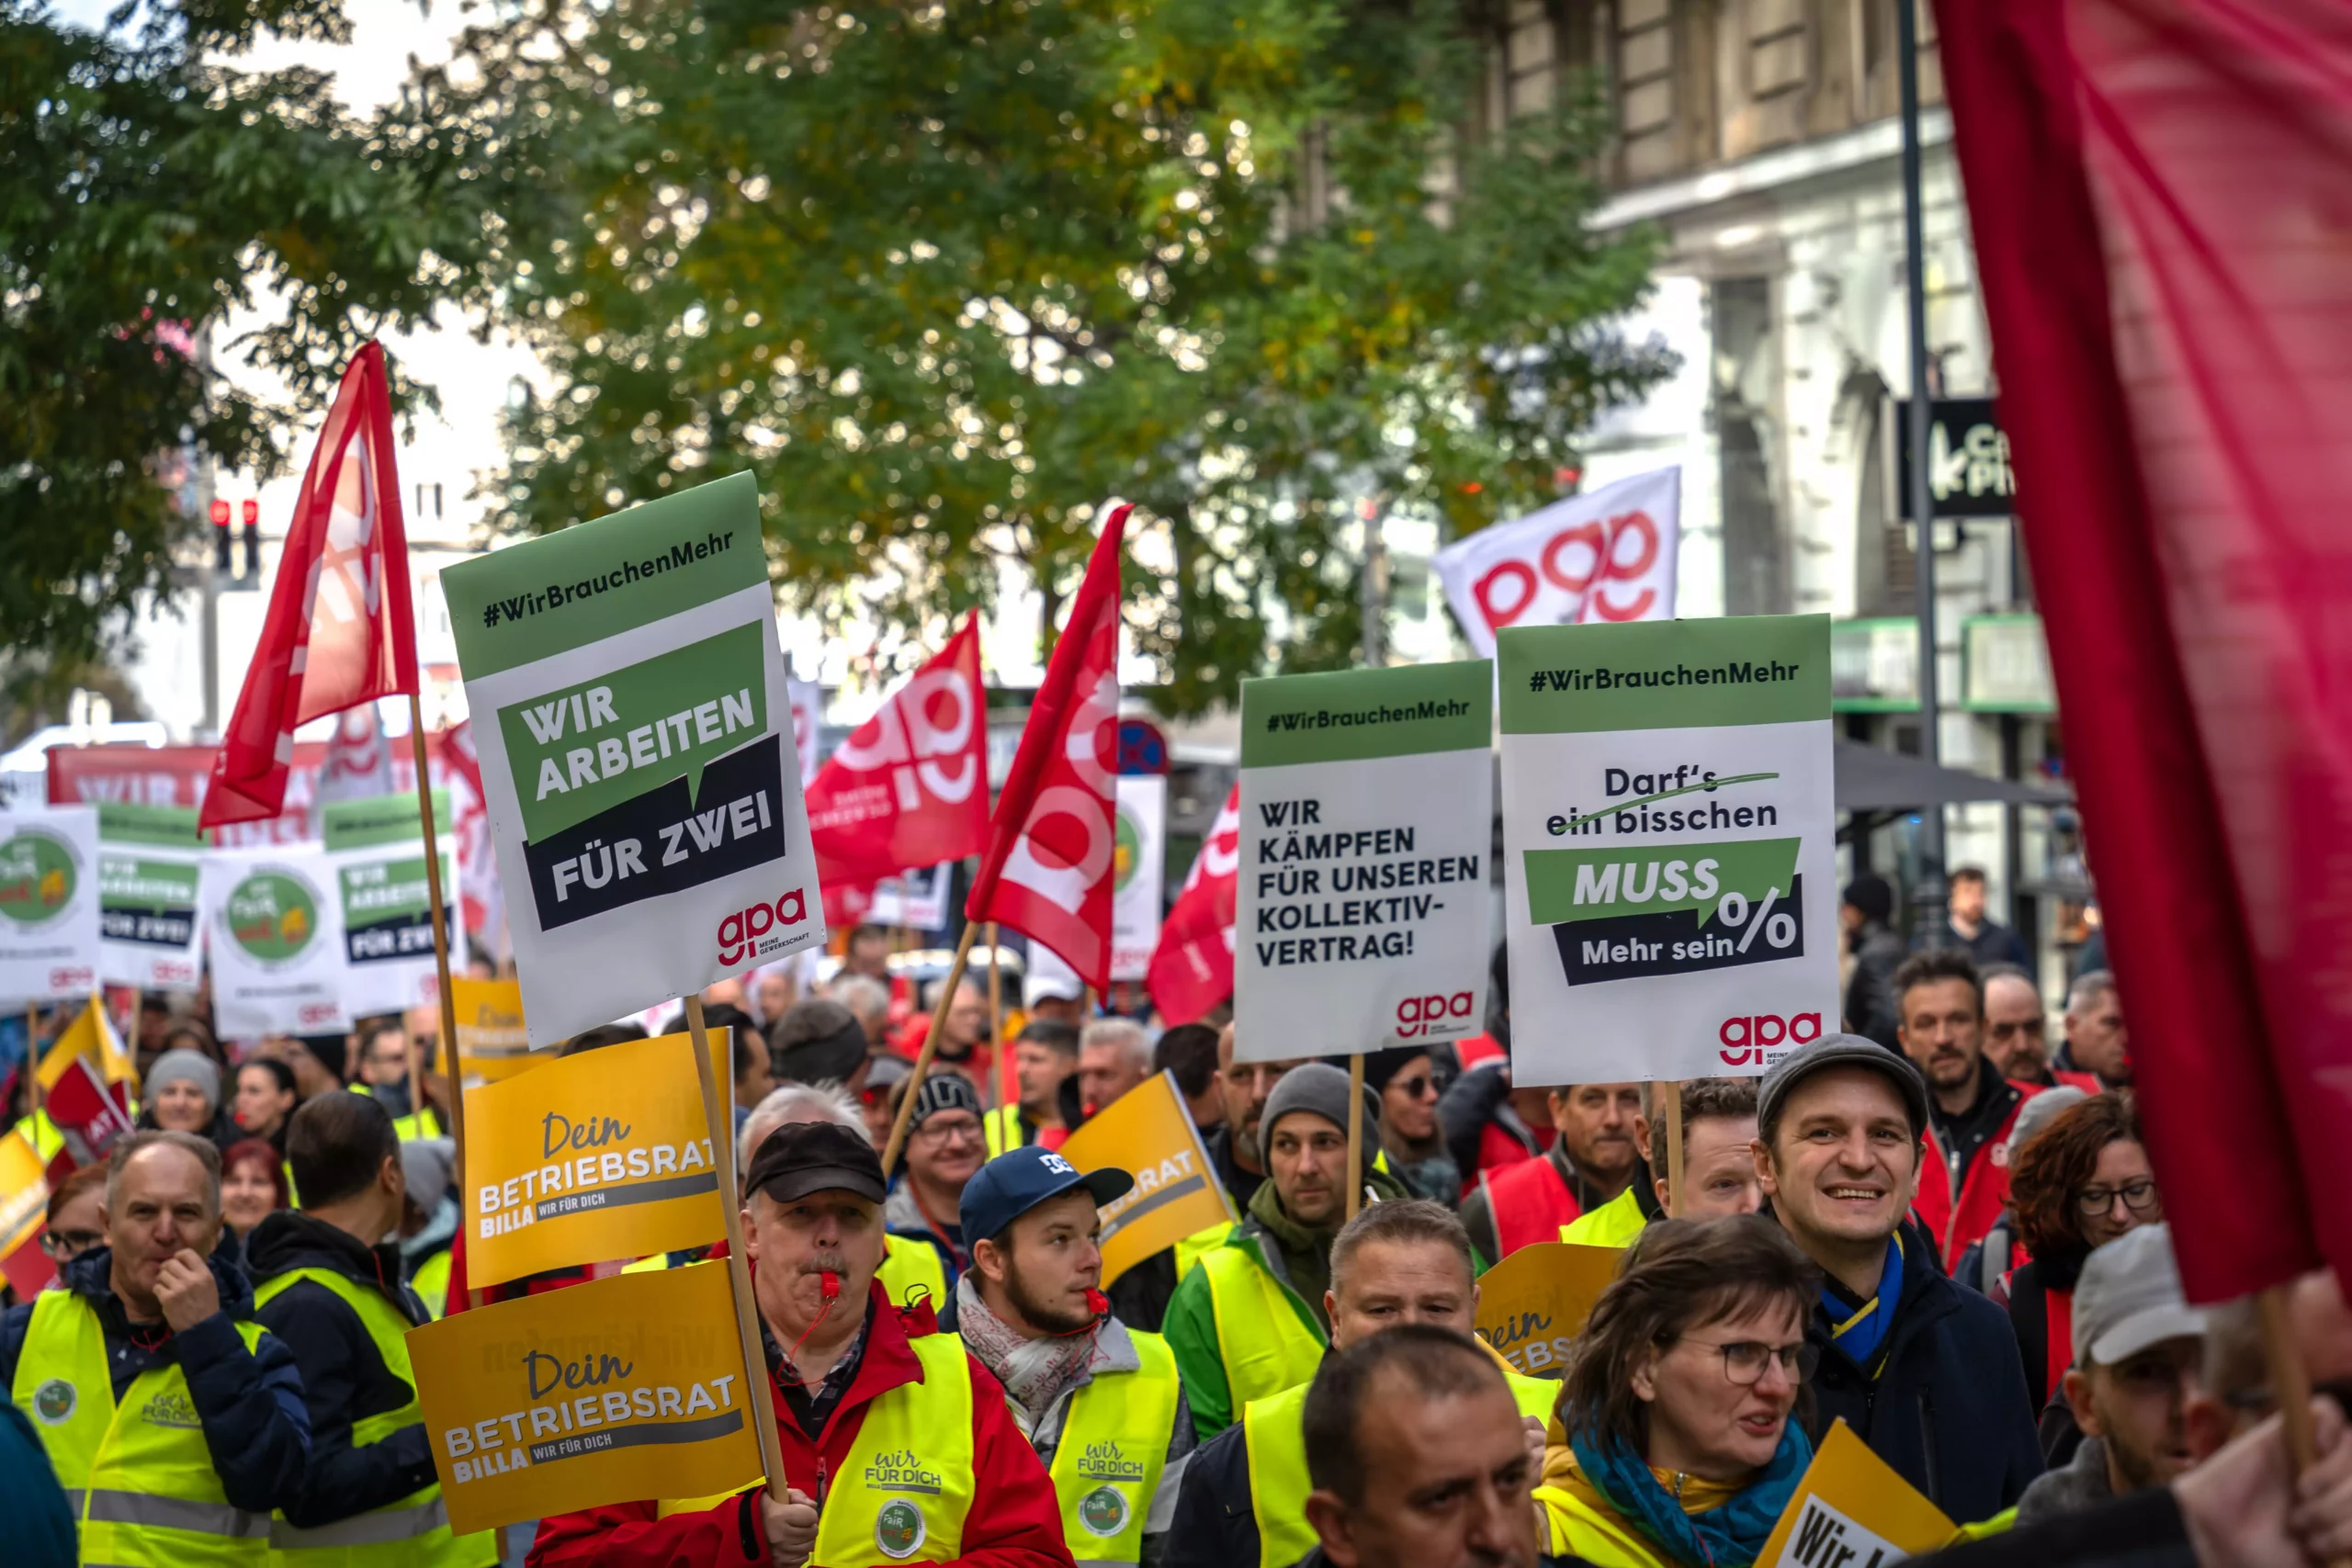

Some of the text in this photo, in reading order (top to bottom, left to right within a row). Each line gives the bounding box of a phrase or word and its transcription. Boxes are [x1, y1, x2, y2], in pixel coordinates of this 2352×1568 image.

[483, 530, 734, 628] #WirBrauchenMehr
[1530, 660, 1799, 693] #WirBrauchenMehr
[520, 685, 619, 745] WIR
[1266, 699, 1470, 732] #WirBrauchenMehr
[537, 688, 754, 801] ARBEITEN
[659, 789, 772, 866] ZWEI
[1260, 799, 1320, 827] WIR
[1546, 800, 1777, 836] ein bisschen
[1259, 827, 1414, 863] KÄMPFEN
[552, 838, 649, 902] FÜR
[1258, 855, 1478, 898] FÜR UNSEREN
[1573, 858, 1720, 905] MUSS
[718, 887, 808, 966] gpa
[1258, 894, 1445, 933] KOLLEKTIV-
[759, 937, 779, 948] MEINE
[760, 931, 810, 954] GEWERKSCHAFT
[1257, 930, 1414, 967] VERTRAG!
[1582, 937, 1663, 964] Mehr
[1672, 933, 1734, 961] sein
[1396, 990, 1473, 1039] gpa
[1720, 1012, 1822, 1066] gpa
[542, 1111, 632, 1159] Dein
[479, 1192, 606, 1239] BILLA WIR FÜR DICH
[522, 1349, 634, 1400] Dein
[445, 1374, 735, 1459] BETRIEBSRAT
[452, 1433, 613, 1484] BILLA WIR FÜR DICH
[875, 1449, 922, 1468] wir
[1078, 1456, 1143, 1474] FÜR DICH
[1086, 1440, 1124, 1460] wir
[865, 1466, 942, 1485] FÜR DICH
